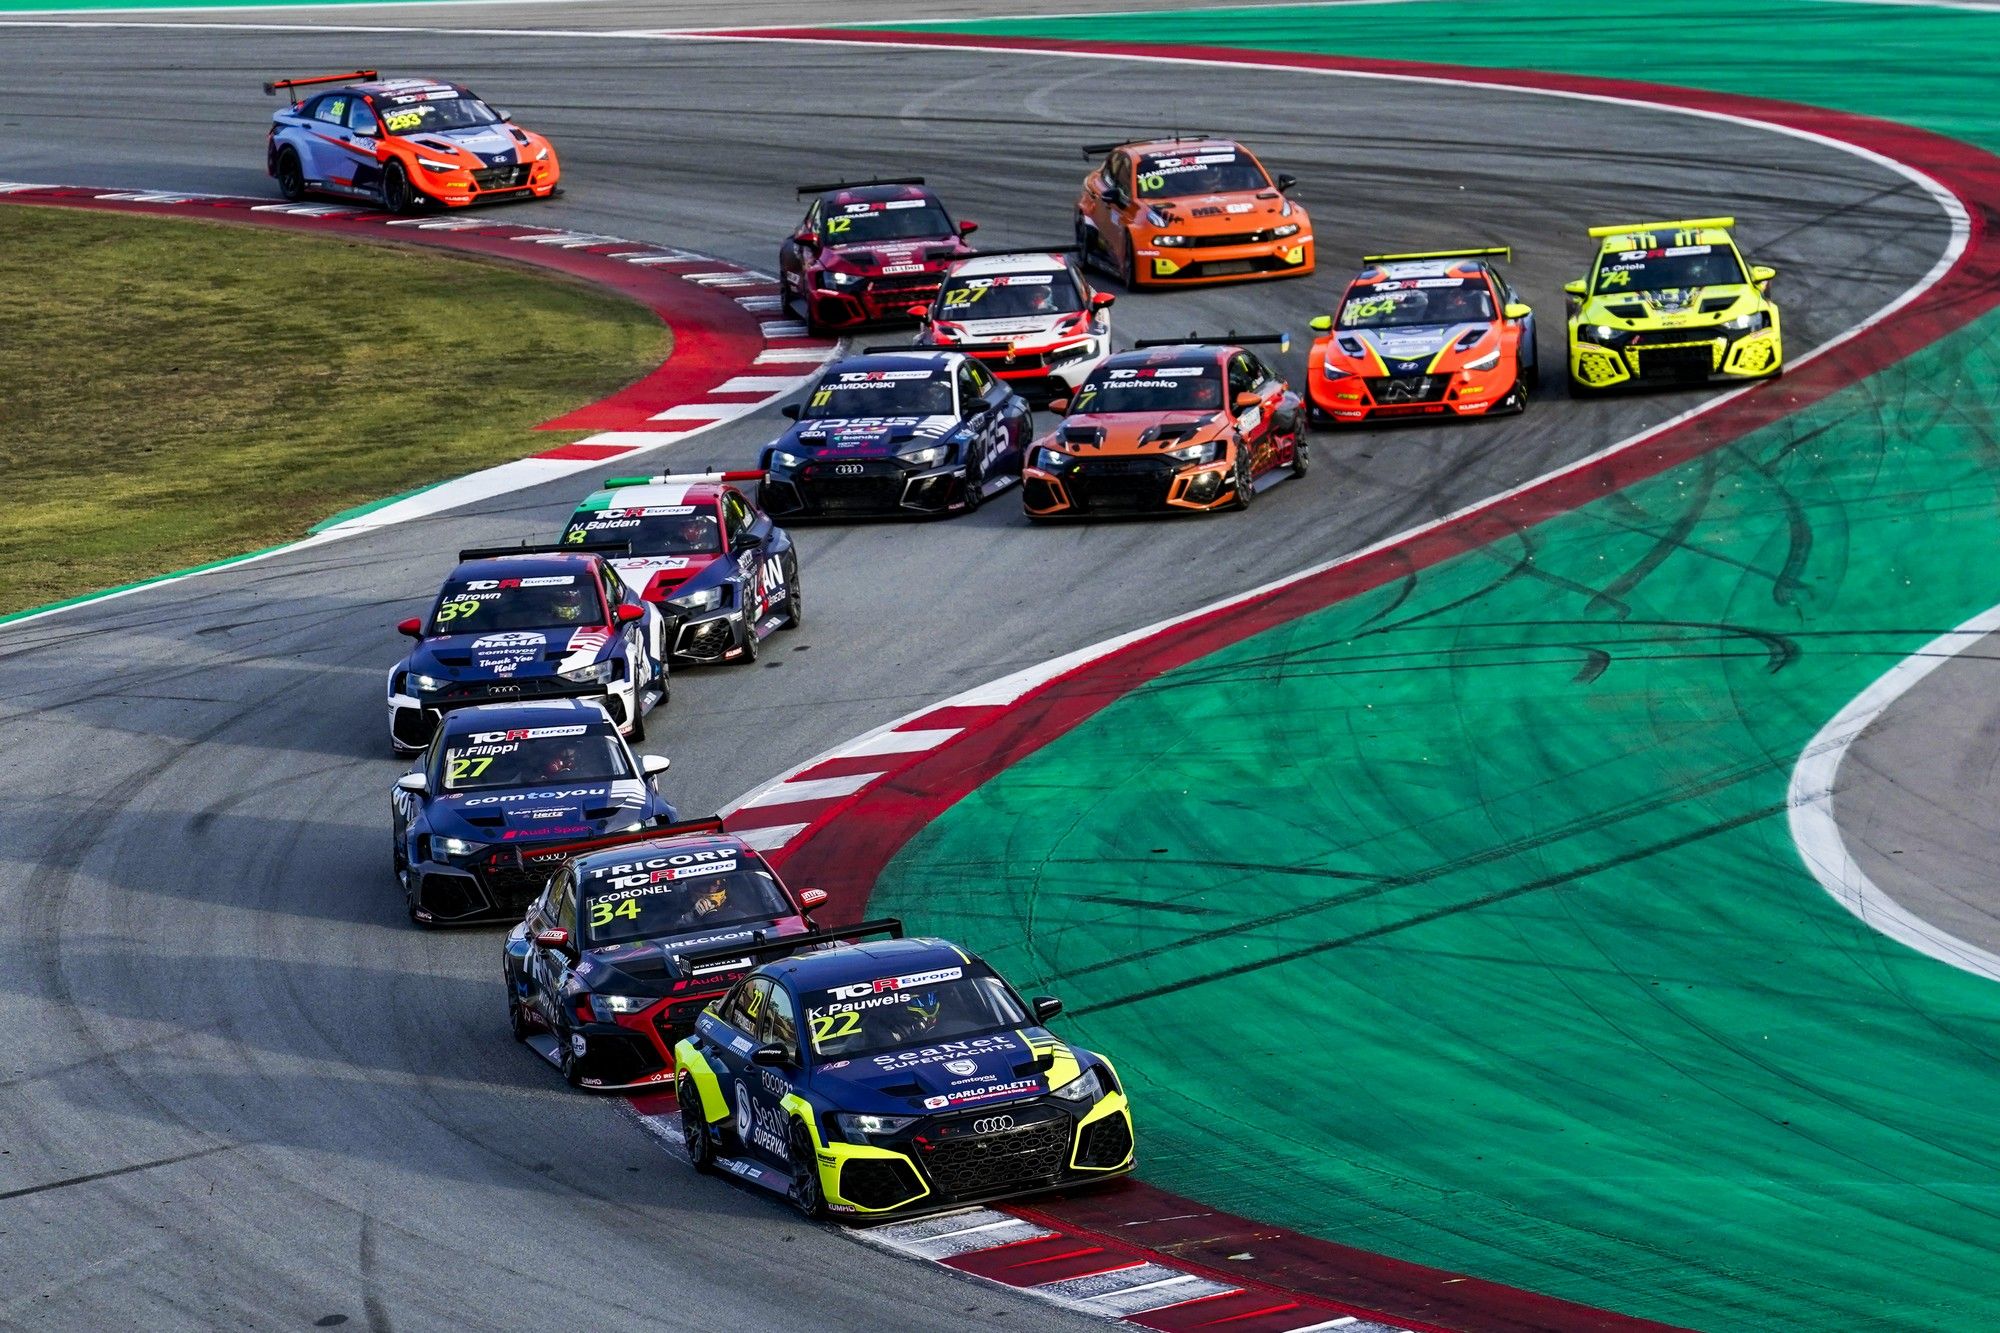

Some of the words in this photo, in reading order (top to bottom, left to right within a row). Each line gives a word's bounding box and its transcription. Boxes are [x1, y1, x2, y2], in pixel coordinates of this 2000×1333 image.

[387, 114, 421, 131] 293
[1138, 175, 1164, 192] 10
[844, 203, 886, 213] TCR
[827, 218, 851, 234] 12
[1618, 249, 1665, 261] TCR
[966, 276, 1009, 289] TCR
[1373, 279, 1419, 292] TCR
[1601, 270, 1631, 289] 74
[945, 287, 988, 305] 127
[840, 371, 885, 382] TCR
[1110, 368, 1156, 379] TCR
[1102, 380, 1178, 390] Tkachenko
[811, 391, 832, 407] 11
[1078, 392, 1097, 409] 7
[594, 507, 645, 520] TCR
[466, 578, 521, 591] TCR
[437, 600, 480, 622] 39
[480, 656, 511, 667] Thank
[468, 729, 529, 744] TCR
[452, 757, 493, 779] 27
[465, 788, 606, 806] comtoyou
[590, 848, 737, 878] TRICORP
[607, 869, 676, 890] TCR
[678, 862, 735, 874] Europe
[590, 899, 641, 928] 34
[693, 959, 736, 969] WORKWEAR
[690, 976, 724, 987] Audi
[827, 978, 900, 1000] TCR
[901, 970, 960, 984] Europe
[810, 1011, 863, 1044] 22
[873, 1035, 1010, 1066] SeaNet
[882, 1043, 1017, 1072] SUPERYACHTS
[951, 1074, 996, 1085] comtoyou
[948, 1087, 985, 1100] CARLO
[990, 1079, 1037, 1092] POLETTI
[828, 1203, 856, 1212] KUMHO
